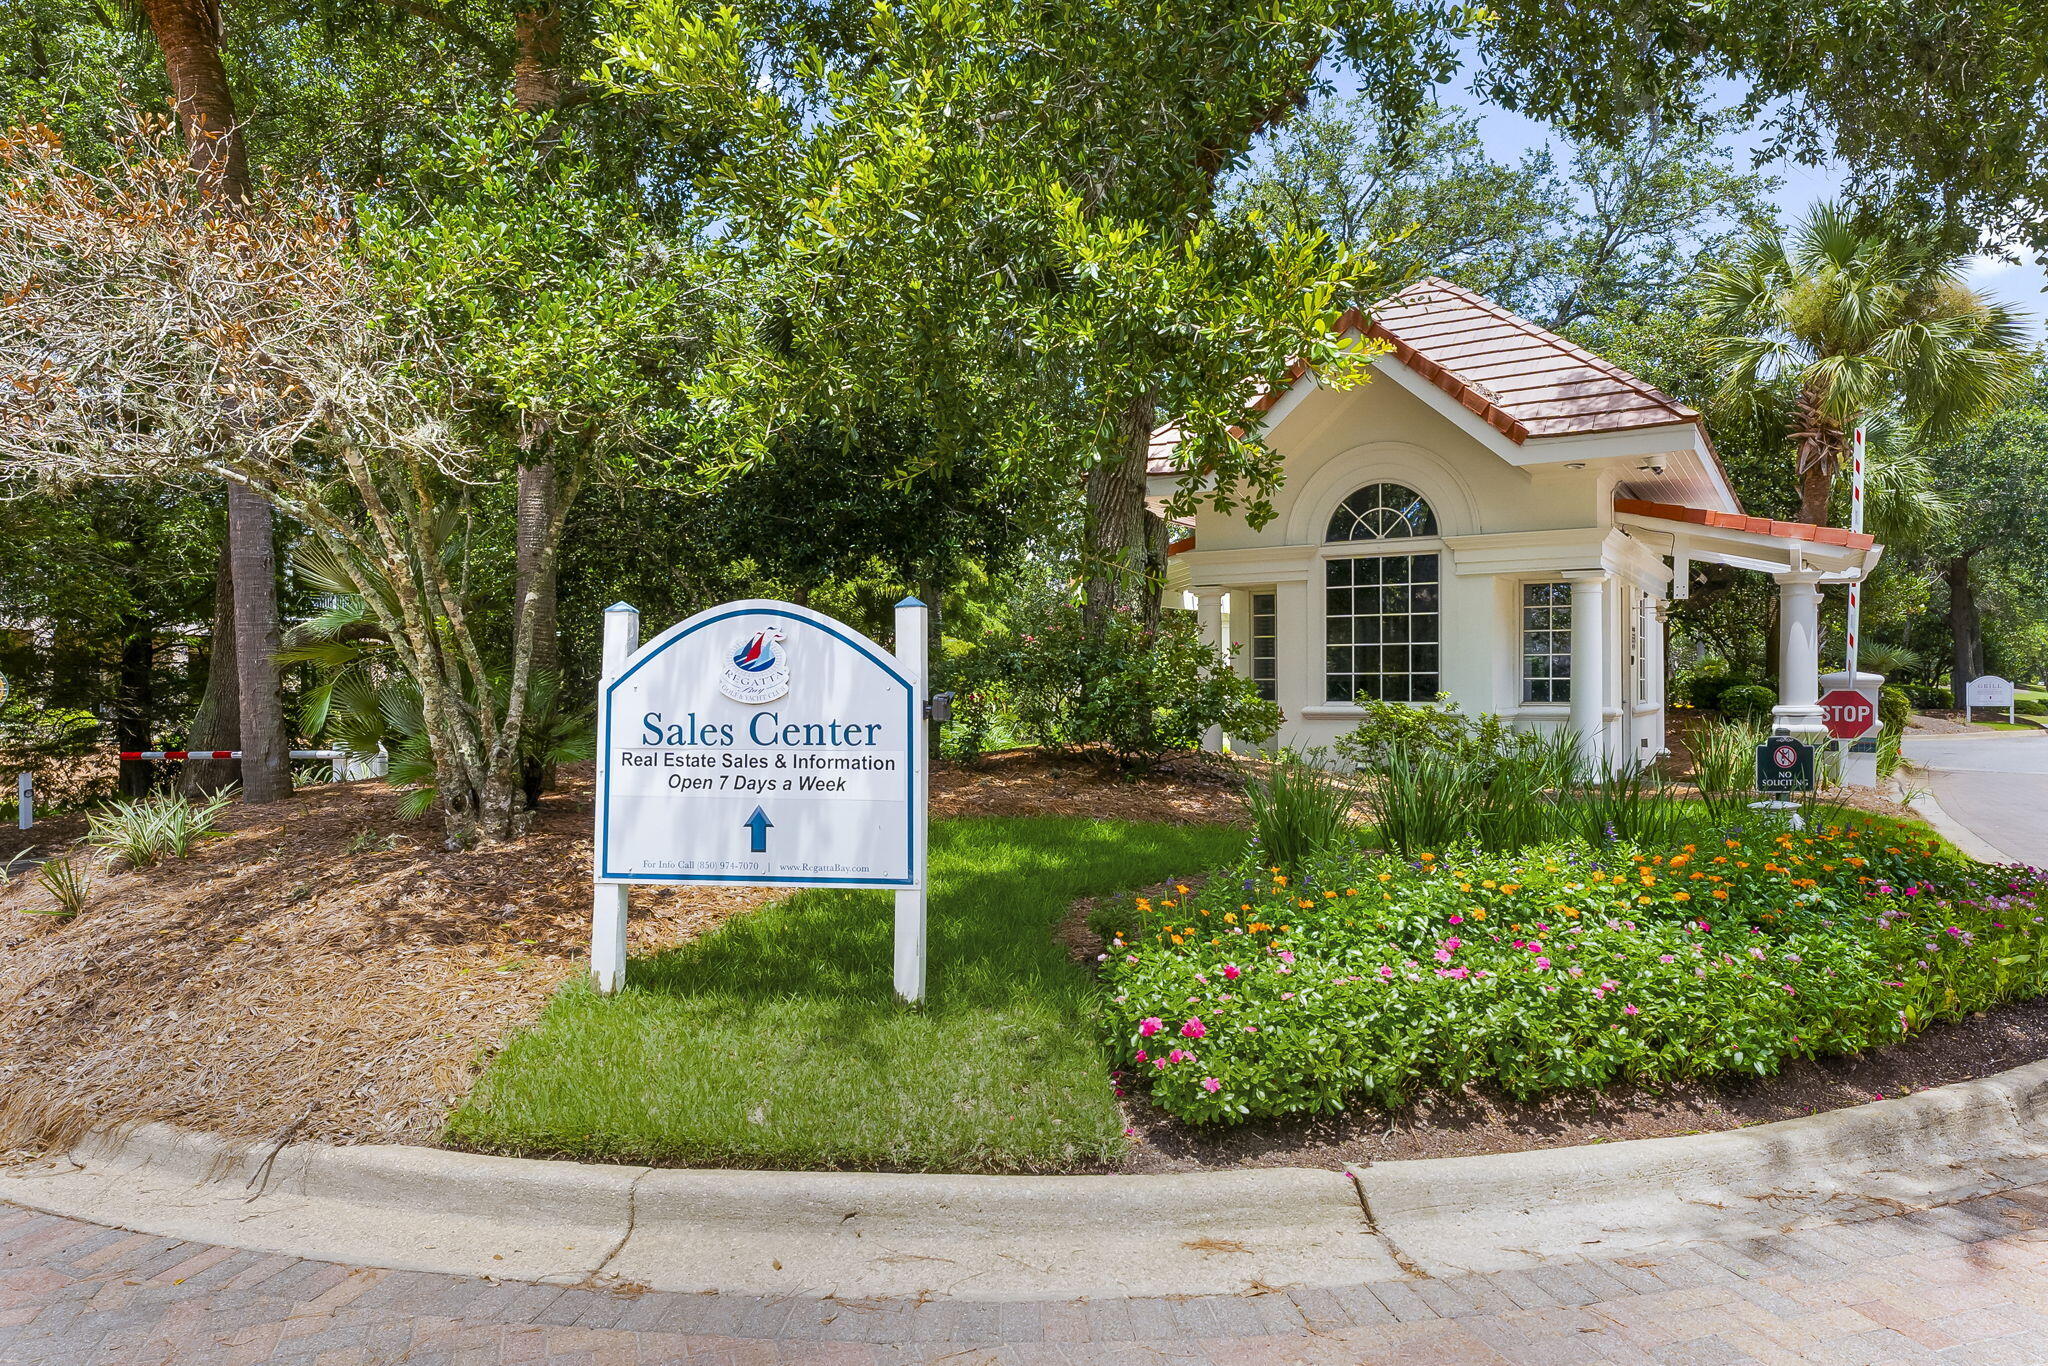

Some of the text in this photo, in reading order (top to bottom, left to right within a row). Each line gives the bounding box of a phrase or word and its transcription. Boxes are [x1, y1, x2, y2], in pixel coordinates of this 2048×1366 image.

[724, 669, 784, 686] REGATTA
[1820, 705, 1870, 722] STOP
[642, 711, 882, 747] Sales Center
[622, 752, 895, 771] Real Estate Sales & Information
[668, 773, 847, 795] Open 7 Days a Week
[643, 860, 759, 871] For Info Call (850) 974-7070
[779, 863, 870, 874] www.RegattaBay.com
